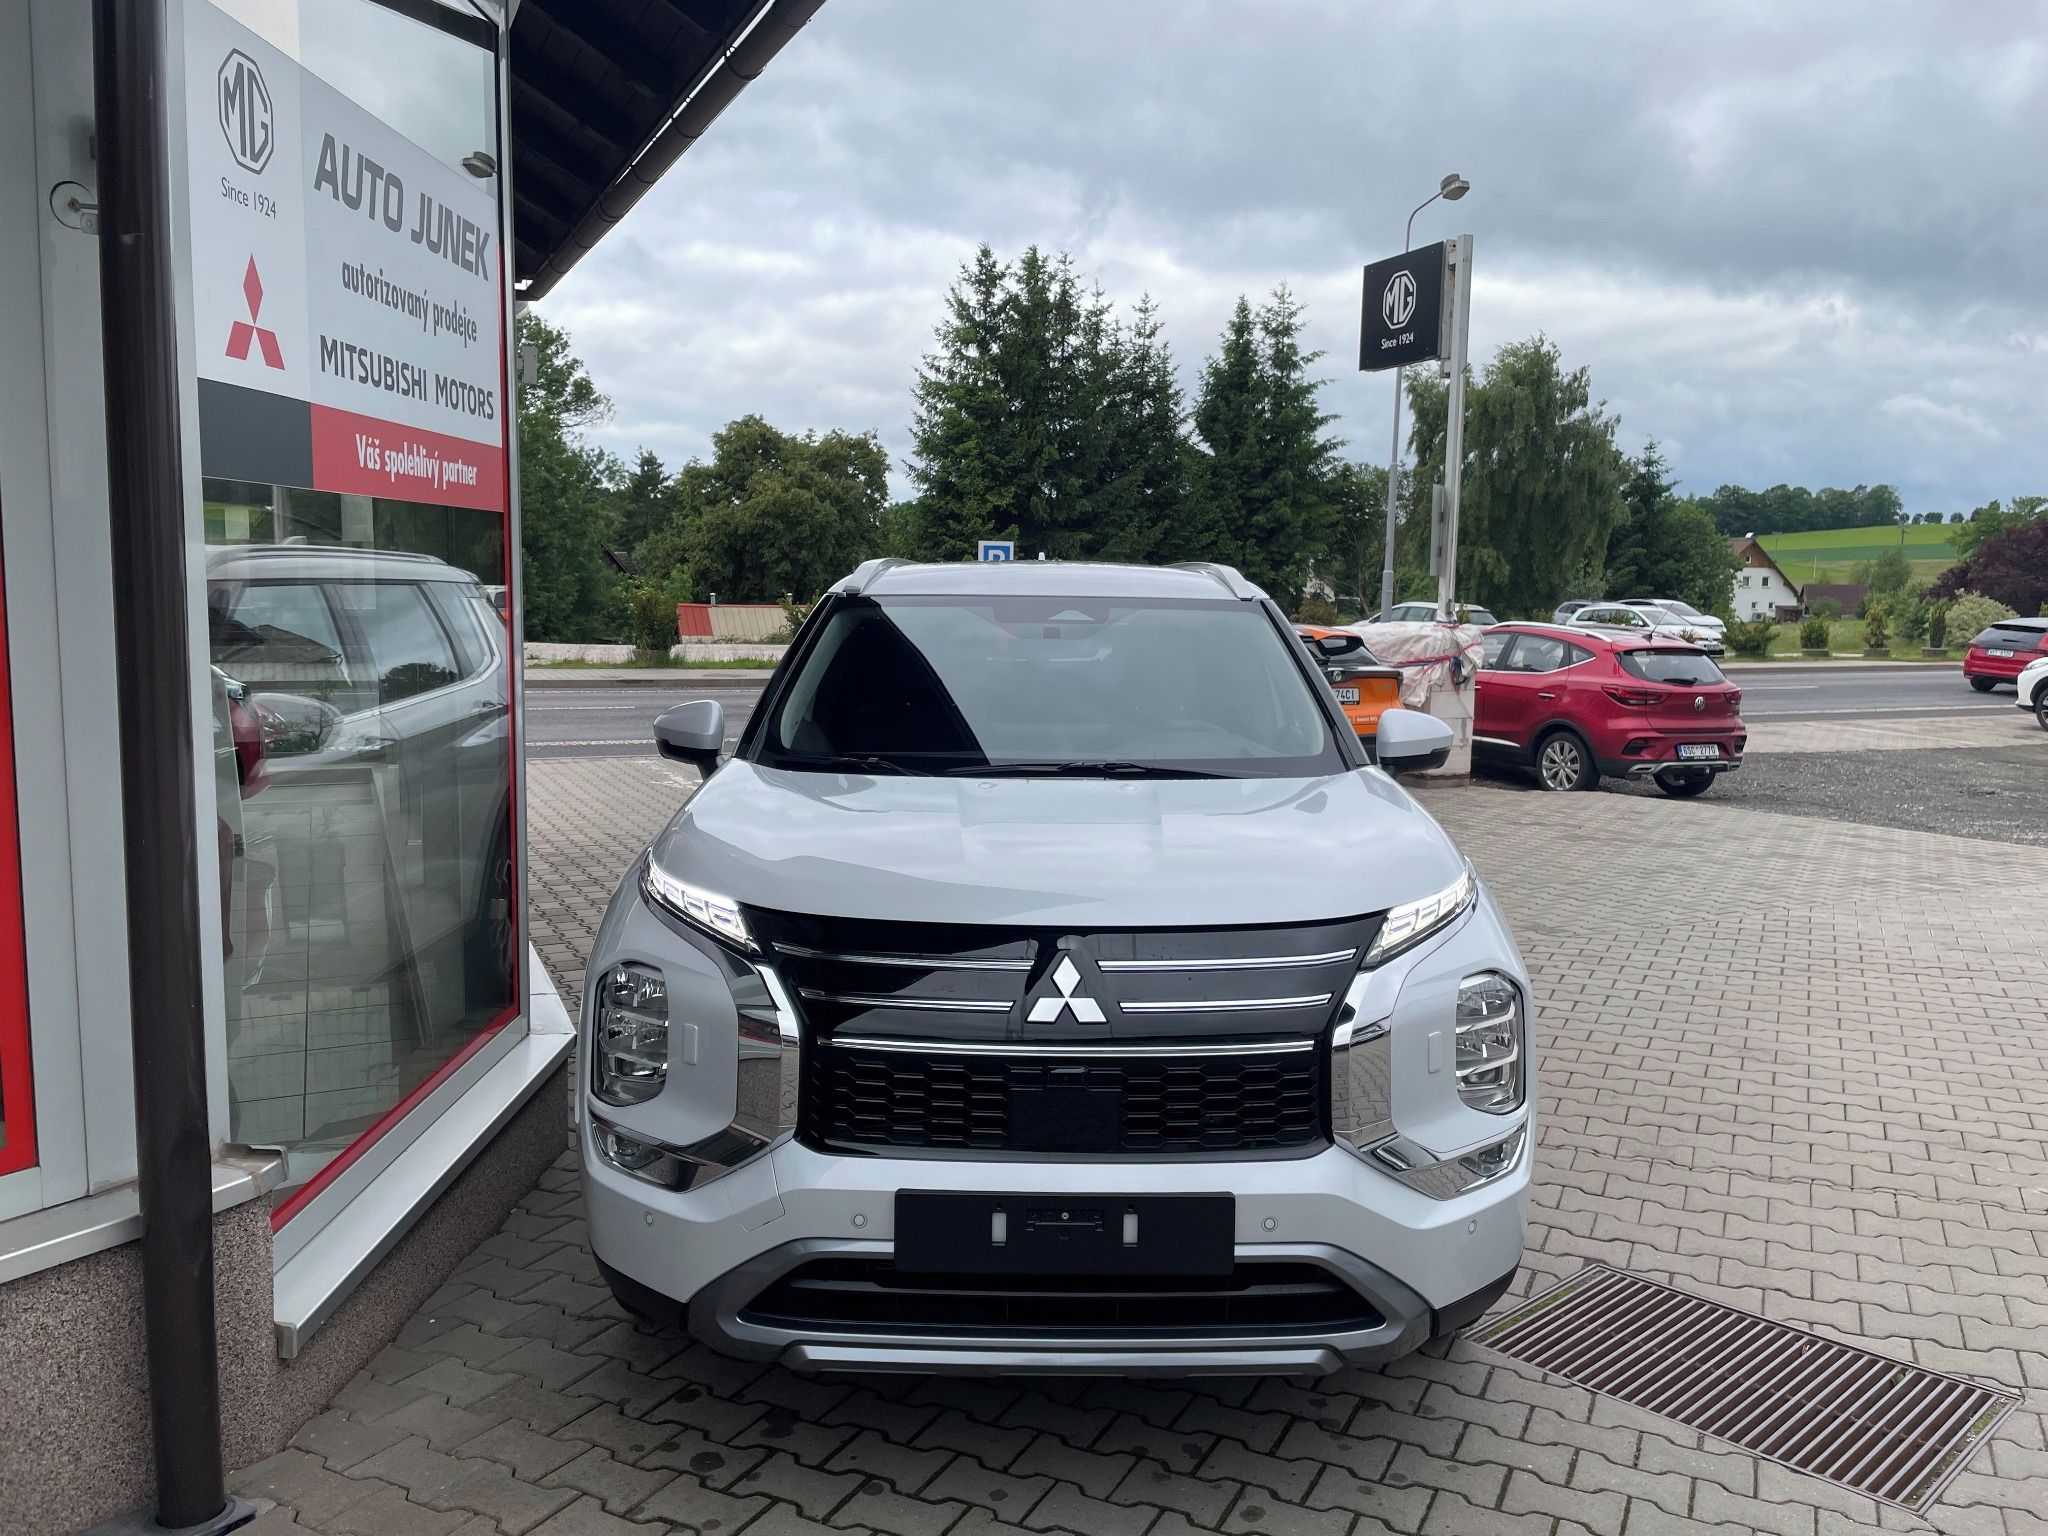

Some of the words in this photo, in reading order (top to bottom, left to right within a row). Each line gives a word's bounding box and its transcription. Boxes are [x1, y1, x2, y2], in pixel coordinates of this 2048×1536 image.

[222, 60, 269, 165] MG
[221, 176, 249, 207] Since
[253, 191, 277, 220] 1924
[313, 131, 404, 233] AUTO
[410, 192, 490, 281] JUNEK
[342, 261, 429, 333] autorizovaný
[433, 297, 477, 349] prodejce
[1385, 274, 1414, 325] MG
[1380, 338, 1397, 350] Since
[1399, 332, 1414, 346] 1924
[319, 334, 428, 402] MITSUBISHI
[434, 373, 494, 420] MOTORS
[355, 433, 381, 470] Váš
[384, 443, 439, 489] spolehlivý
[442, 459, 478, 490] partner
